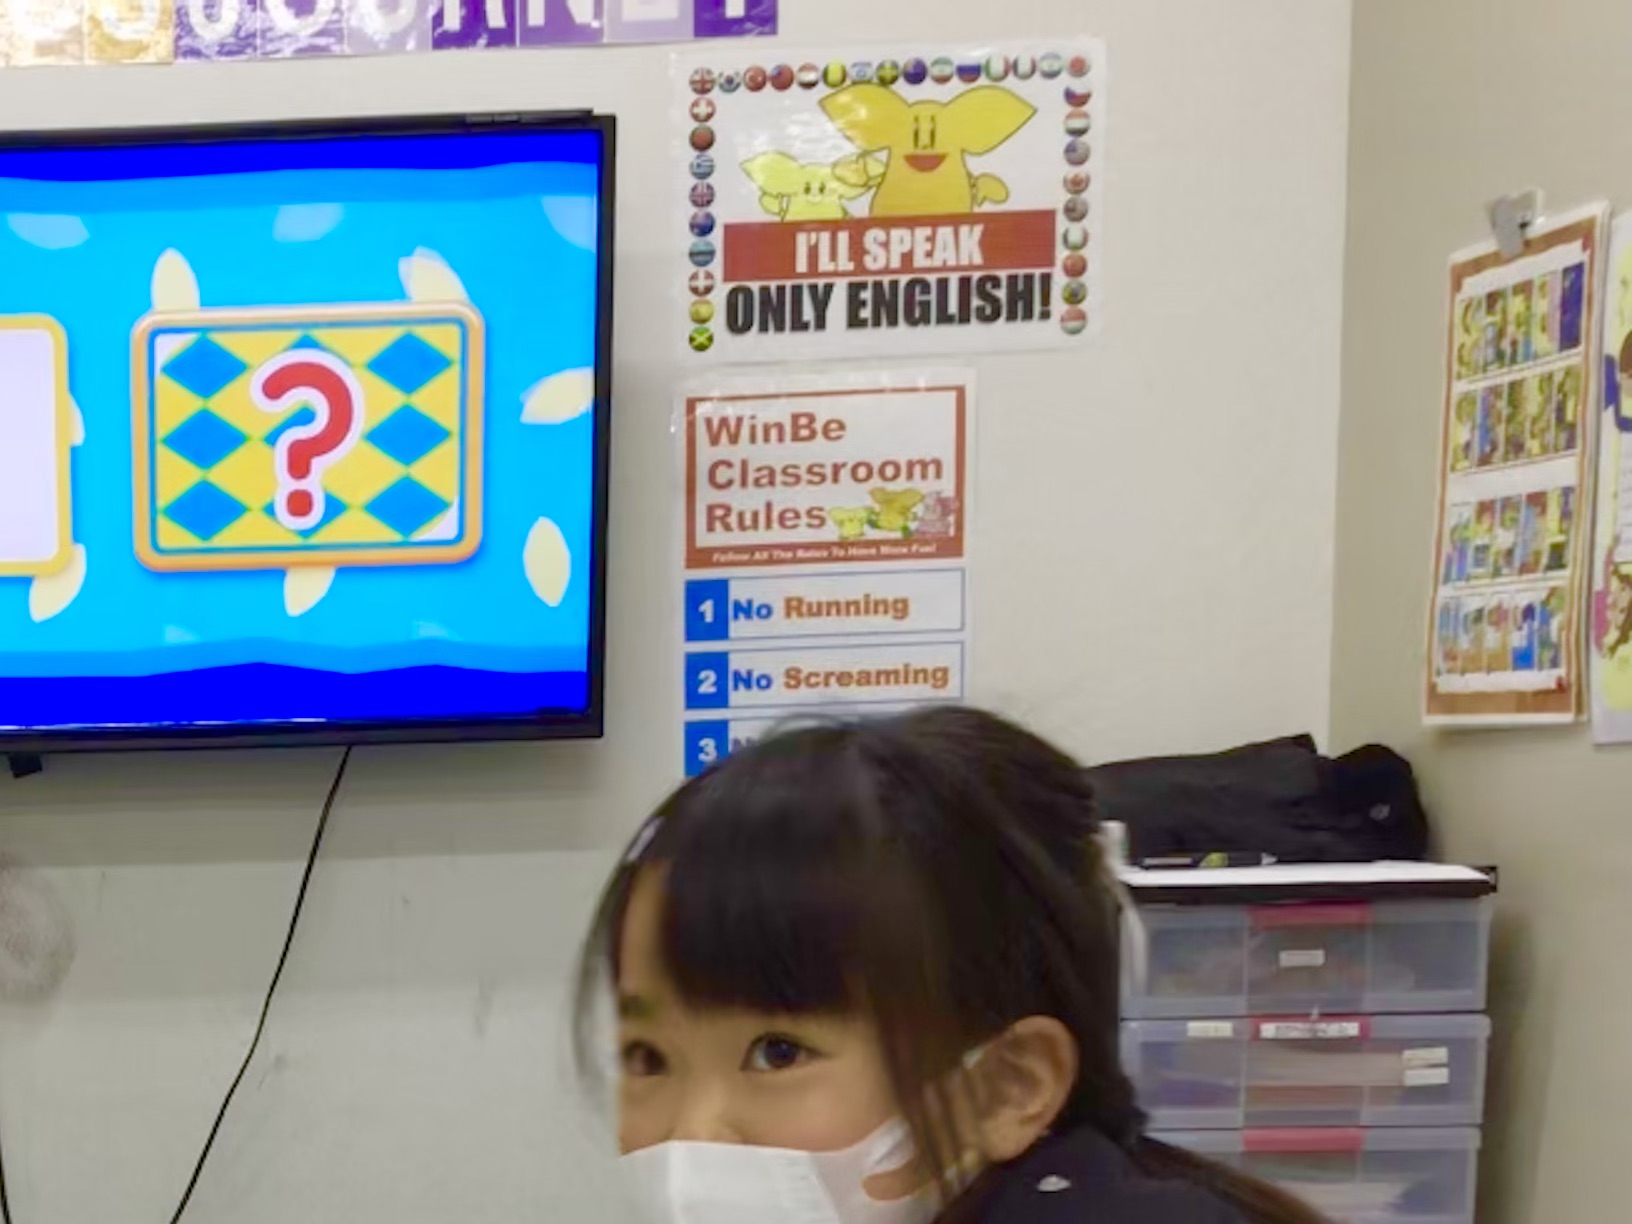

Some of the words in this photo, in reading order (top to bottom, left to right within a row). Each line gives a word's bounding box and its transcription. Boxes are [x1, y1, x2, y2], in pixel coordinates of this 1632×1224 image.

[863, 223, 984, 271] SPEAK
[724, 282, 835, 335] ONLY
[846, 272, 1053, 330] ENGLISH!
[704, 412, 847, 447] WinBe
[706, 456, 944, 490] Classroom
[705, 502, 827, 533] Rules
[697, 598, 715, 623] 1
[732, 598, 774, 622] No
[783, 593, 911, 620] Running
[697, 670, 718, 694] 2
[732, 669, 774, 692] No
[783, 663, 950, 690] Screaming
[697, 737, 717, 762] 3
